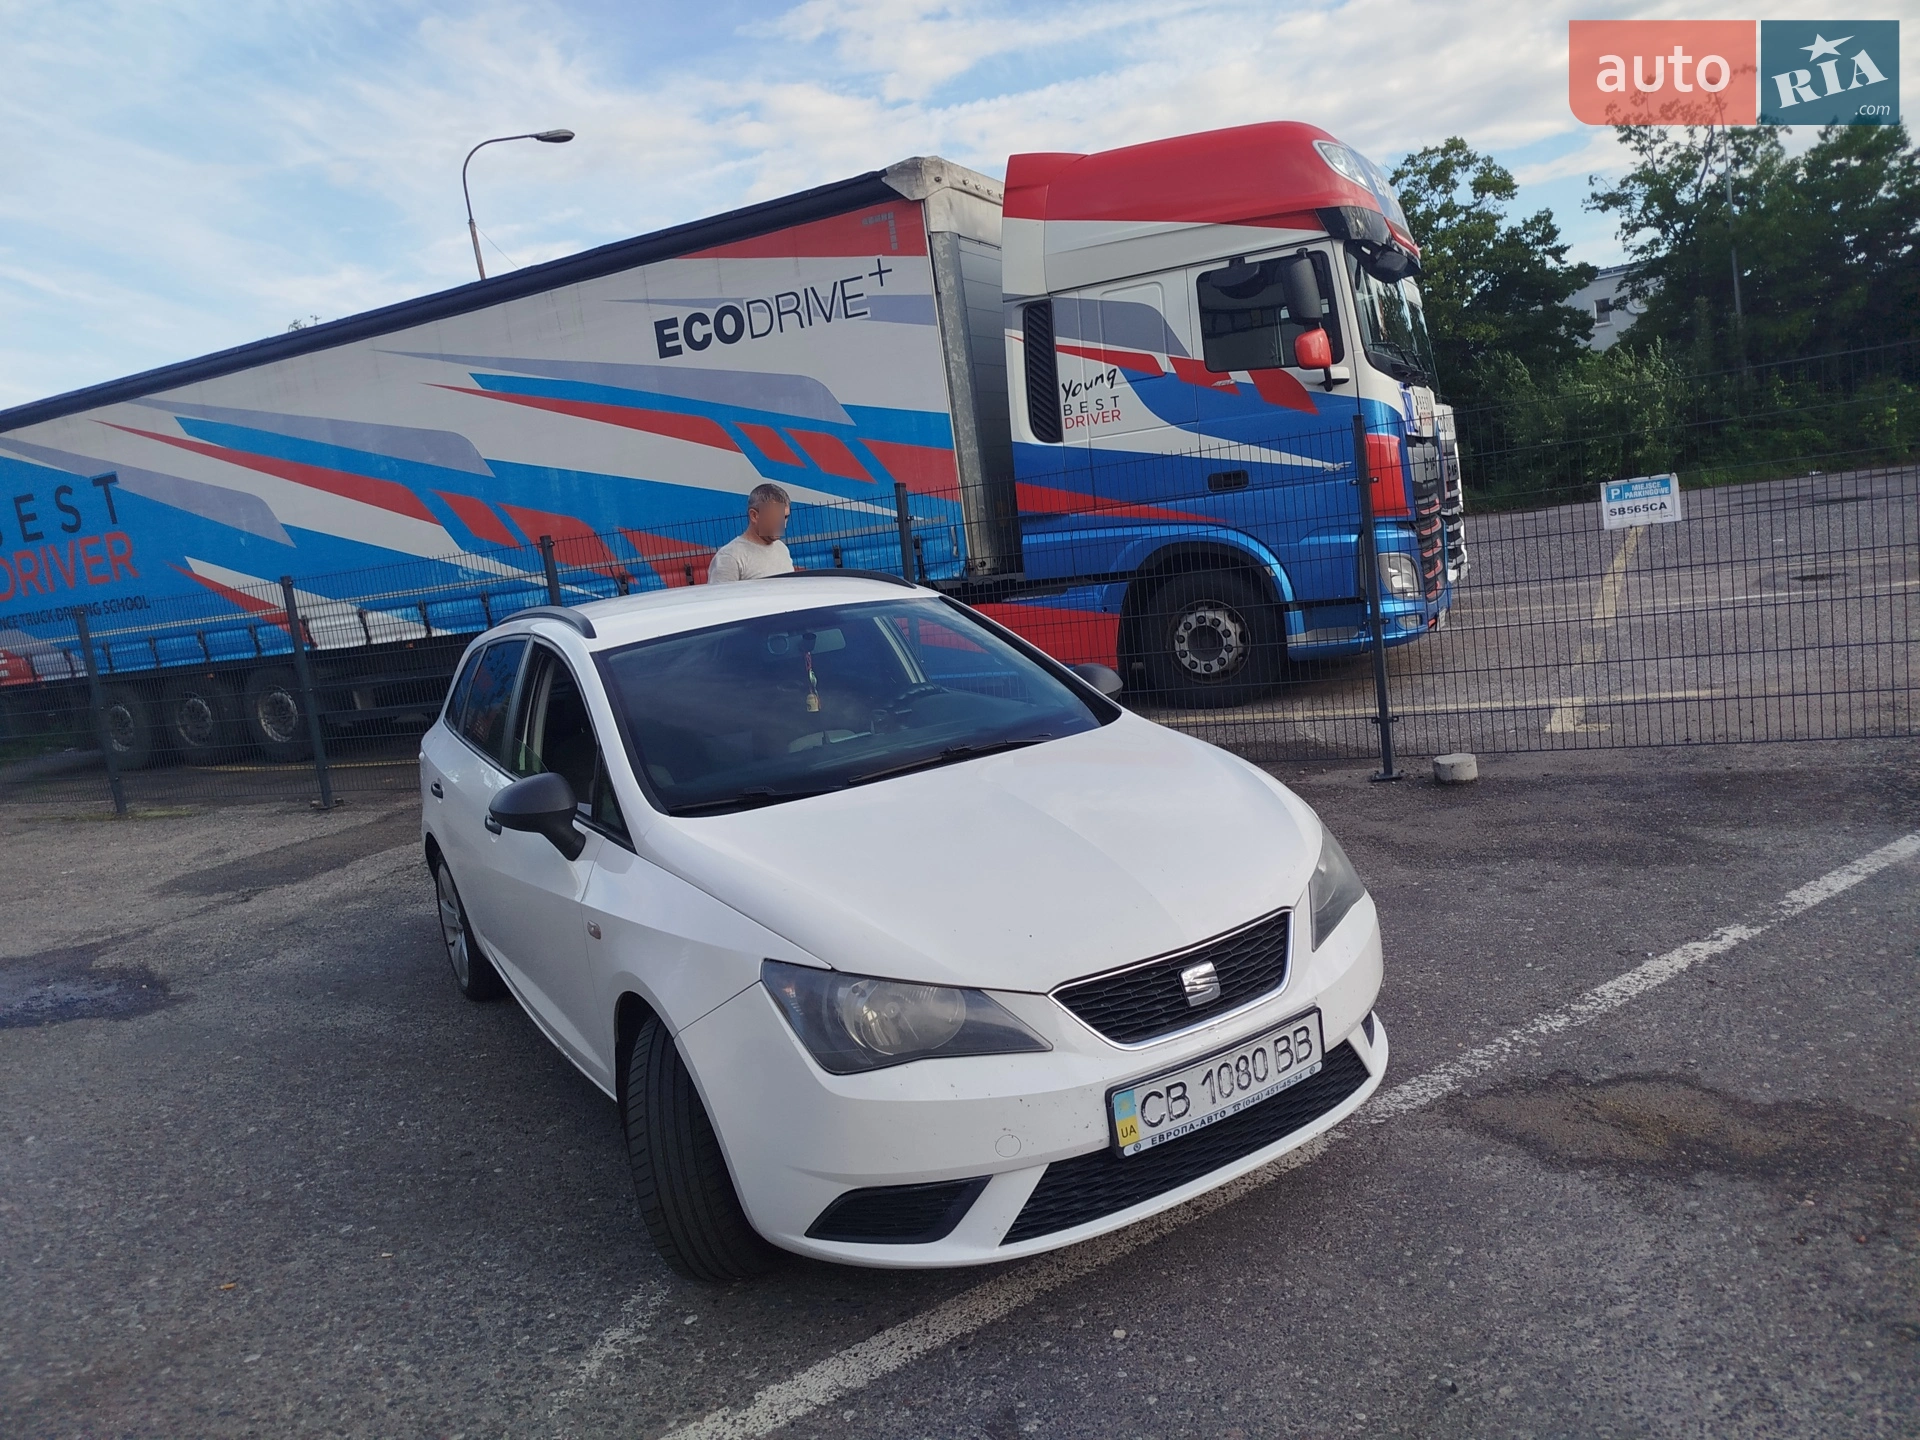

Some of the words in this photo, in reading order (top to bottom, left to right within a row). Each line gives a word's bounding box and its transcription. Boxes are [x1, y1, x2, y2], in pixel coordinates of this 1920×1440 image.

[1061, 368, 1117, 403] Young
[1063, 395, 1119, 416] BEST
[1064, 409, 1121, 430] DRIVER
[1610, 488, 1620, 500] P
[1625, 486, 1670, 499] PARKINGOWE
[1631, 480, 1661, 491] MIEJSCE
[0, 473, 118, 548] EST
[1609, 501, 1668, 516] SB565CA
[19, 609, 55, 627] TRUCK
[55, 602, 102, 621] DRING
[103, 595, 150, 615] SCHOOL
[1140, 1081, 1191, 1128] CB
[1201, 1047, 1269, 1104] 1080
[1273, 1025, 1314, 1074] BB
[1120, 1124, 1137, 1139] UA
[1151, 1110, 1227, 1146] ЕВРОПА-АВТО
